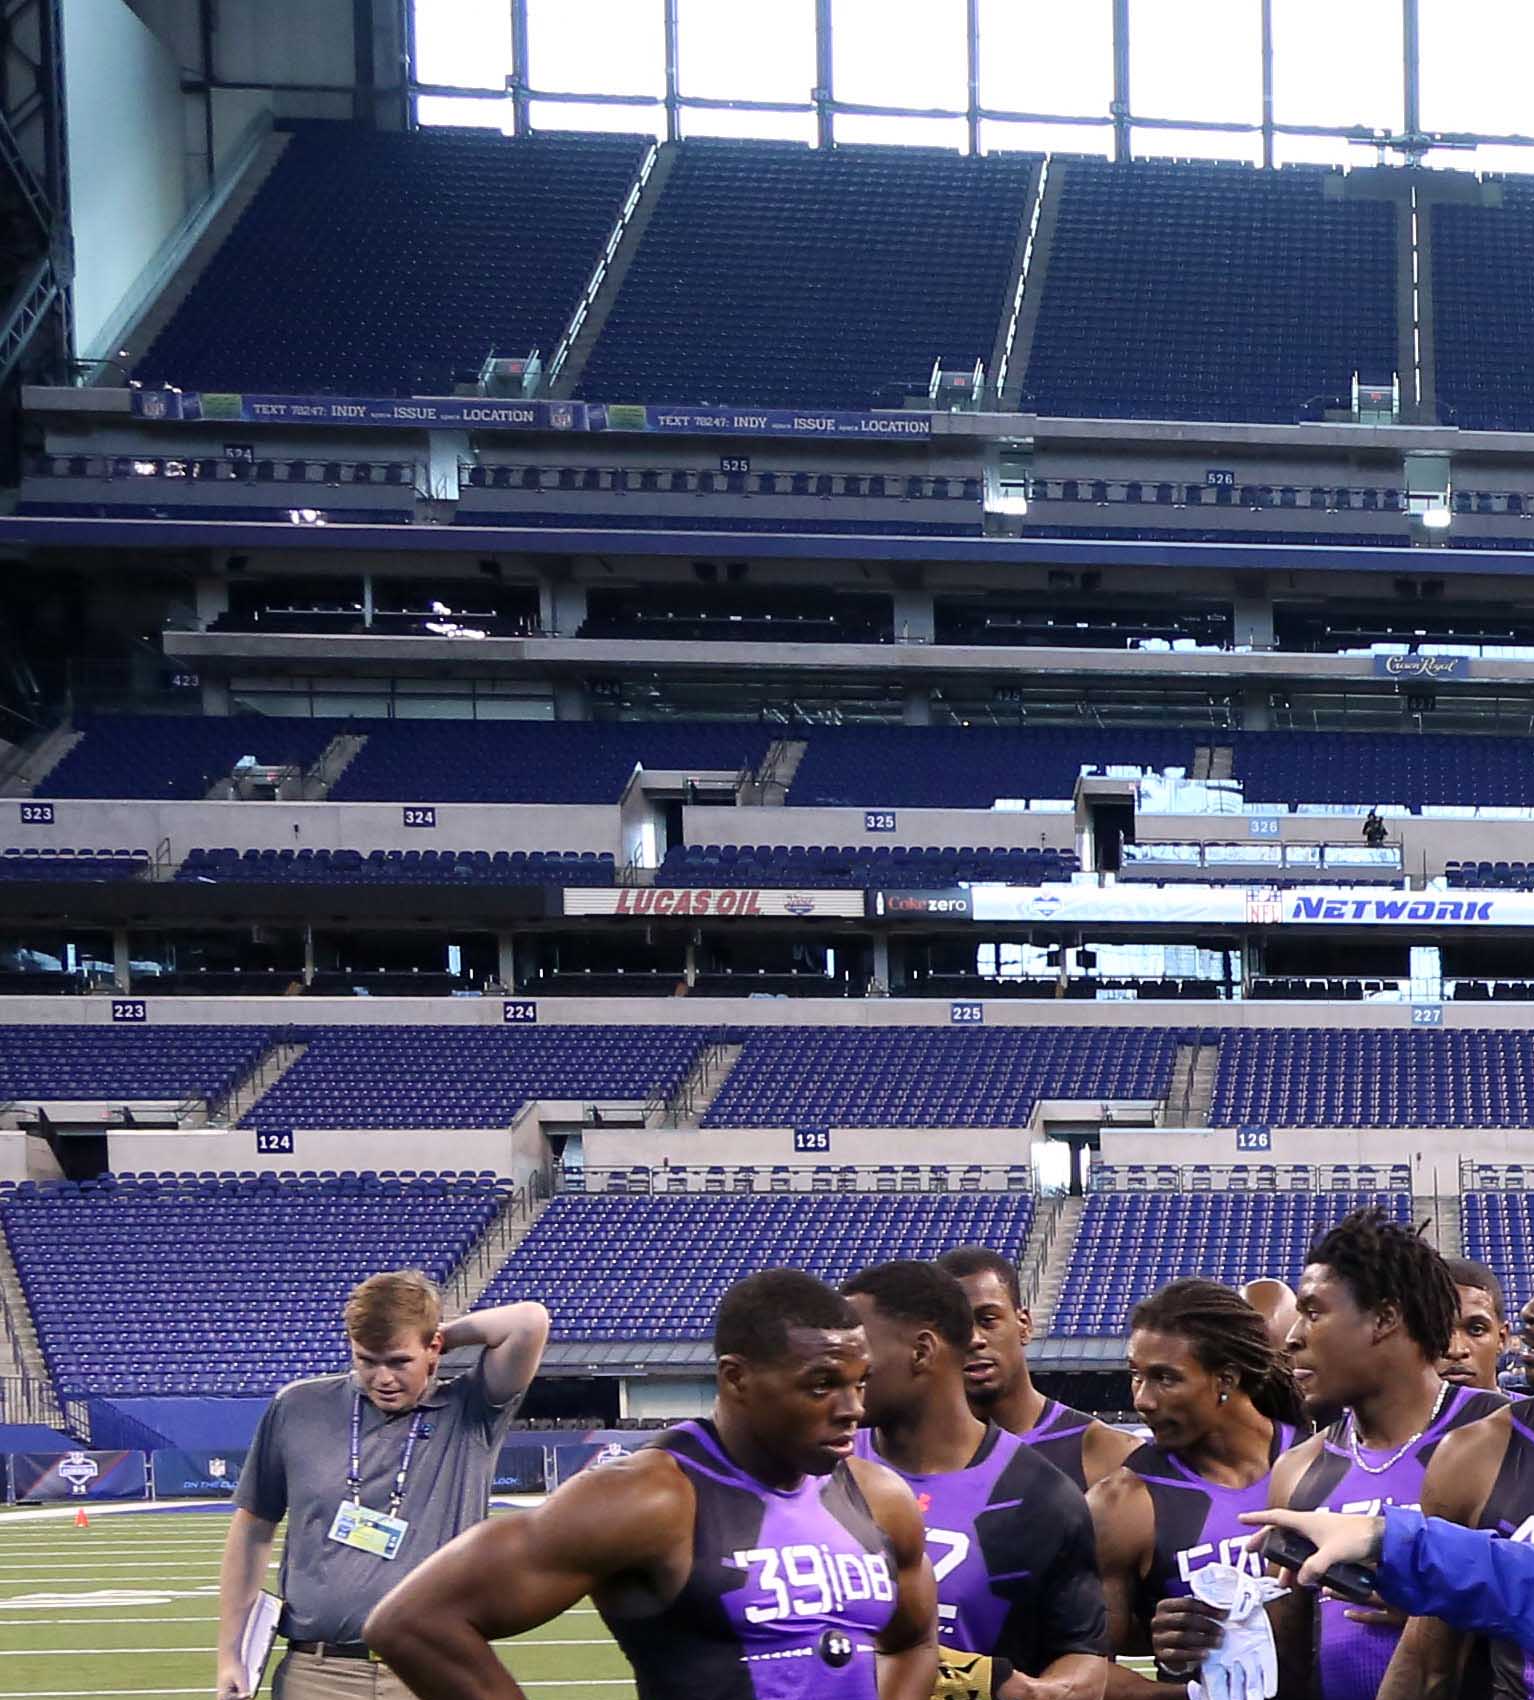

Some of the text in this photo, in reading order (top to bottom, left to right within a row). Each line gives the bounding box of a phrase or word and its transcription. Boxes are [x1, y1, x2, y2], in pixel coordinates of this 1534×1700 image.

[254, 404, 286, 415] TEXT
[331, 405, 366, 417] INDY
[393, 408, 436, 421] ISSUE
[463, 408, 534, 423] LOCATION
[658, 415, 689, 426] TEXT
[734, 417, 767, 429] INDY
[794, 418, 836, 431] ISSUE
[861, 420, 930, 433] LOCATION
[722, 460, 748, 472] 525
[1208, 471, 1233, 485] 526
[171, 674, 200, 687] 423
[22, 806, 54, 821] 323
[405, 810, 435, 825] 324
[866, 813, 895, 829] 325
[1251, 819, 1278, 834] 326
[615, 889, 711, 915] LUCAS
[716, 889, 762, 915] OIL
[888, 895, 967, 912] Coke zero
[1292, 896, 1495, 921] NETWORK
[113, 1003, 145, 1019] 223
[505, 1005, 536, 1019] 224
[953, 1006, 982, 1020] 225
[1414, 1009, 1441, 1023] 227
[259, 1134, 291, 1151] 124
[797, 1133, 827, 1149] 125
[1239, 1133, 1269, 1148] 126
[732, 1545, 826, 1624] 39
[840, 1552, 894, 1602] DB
